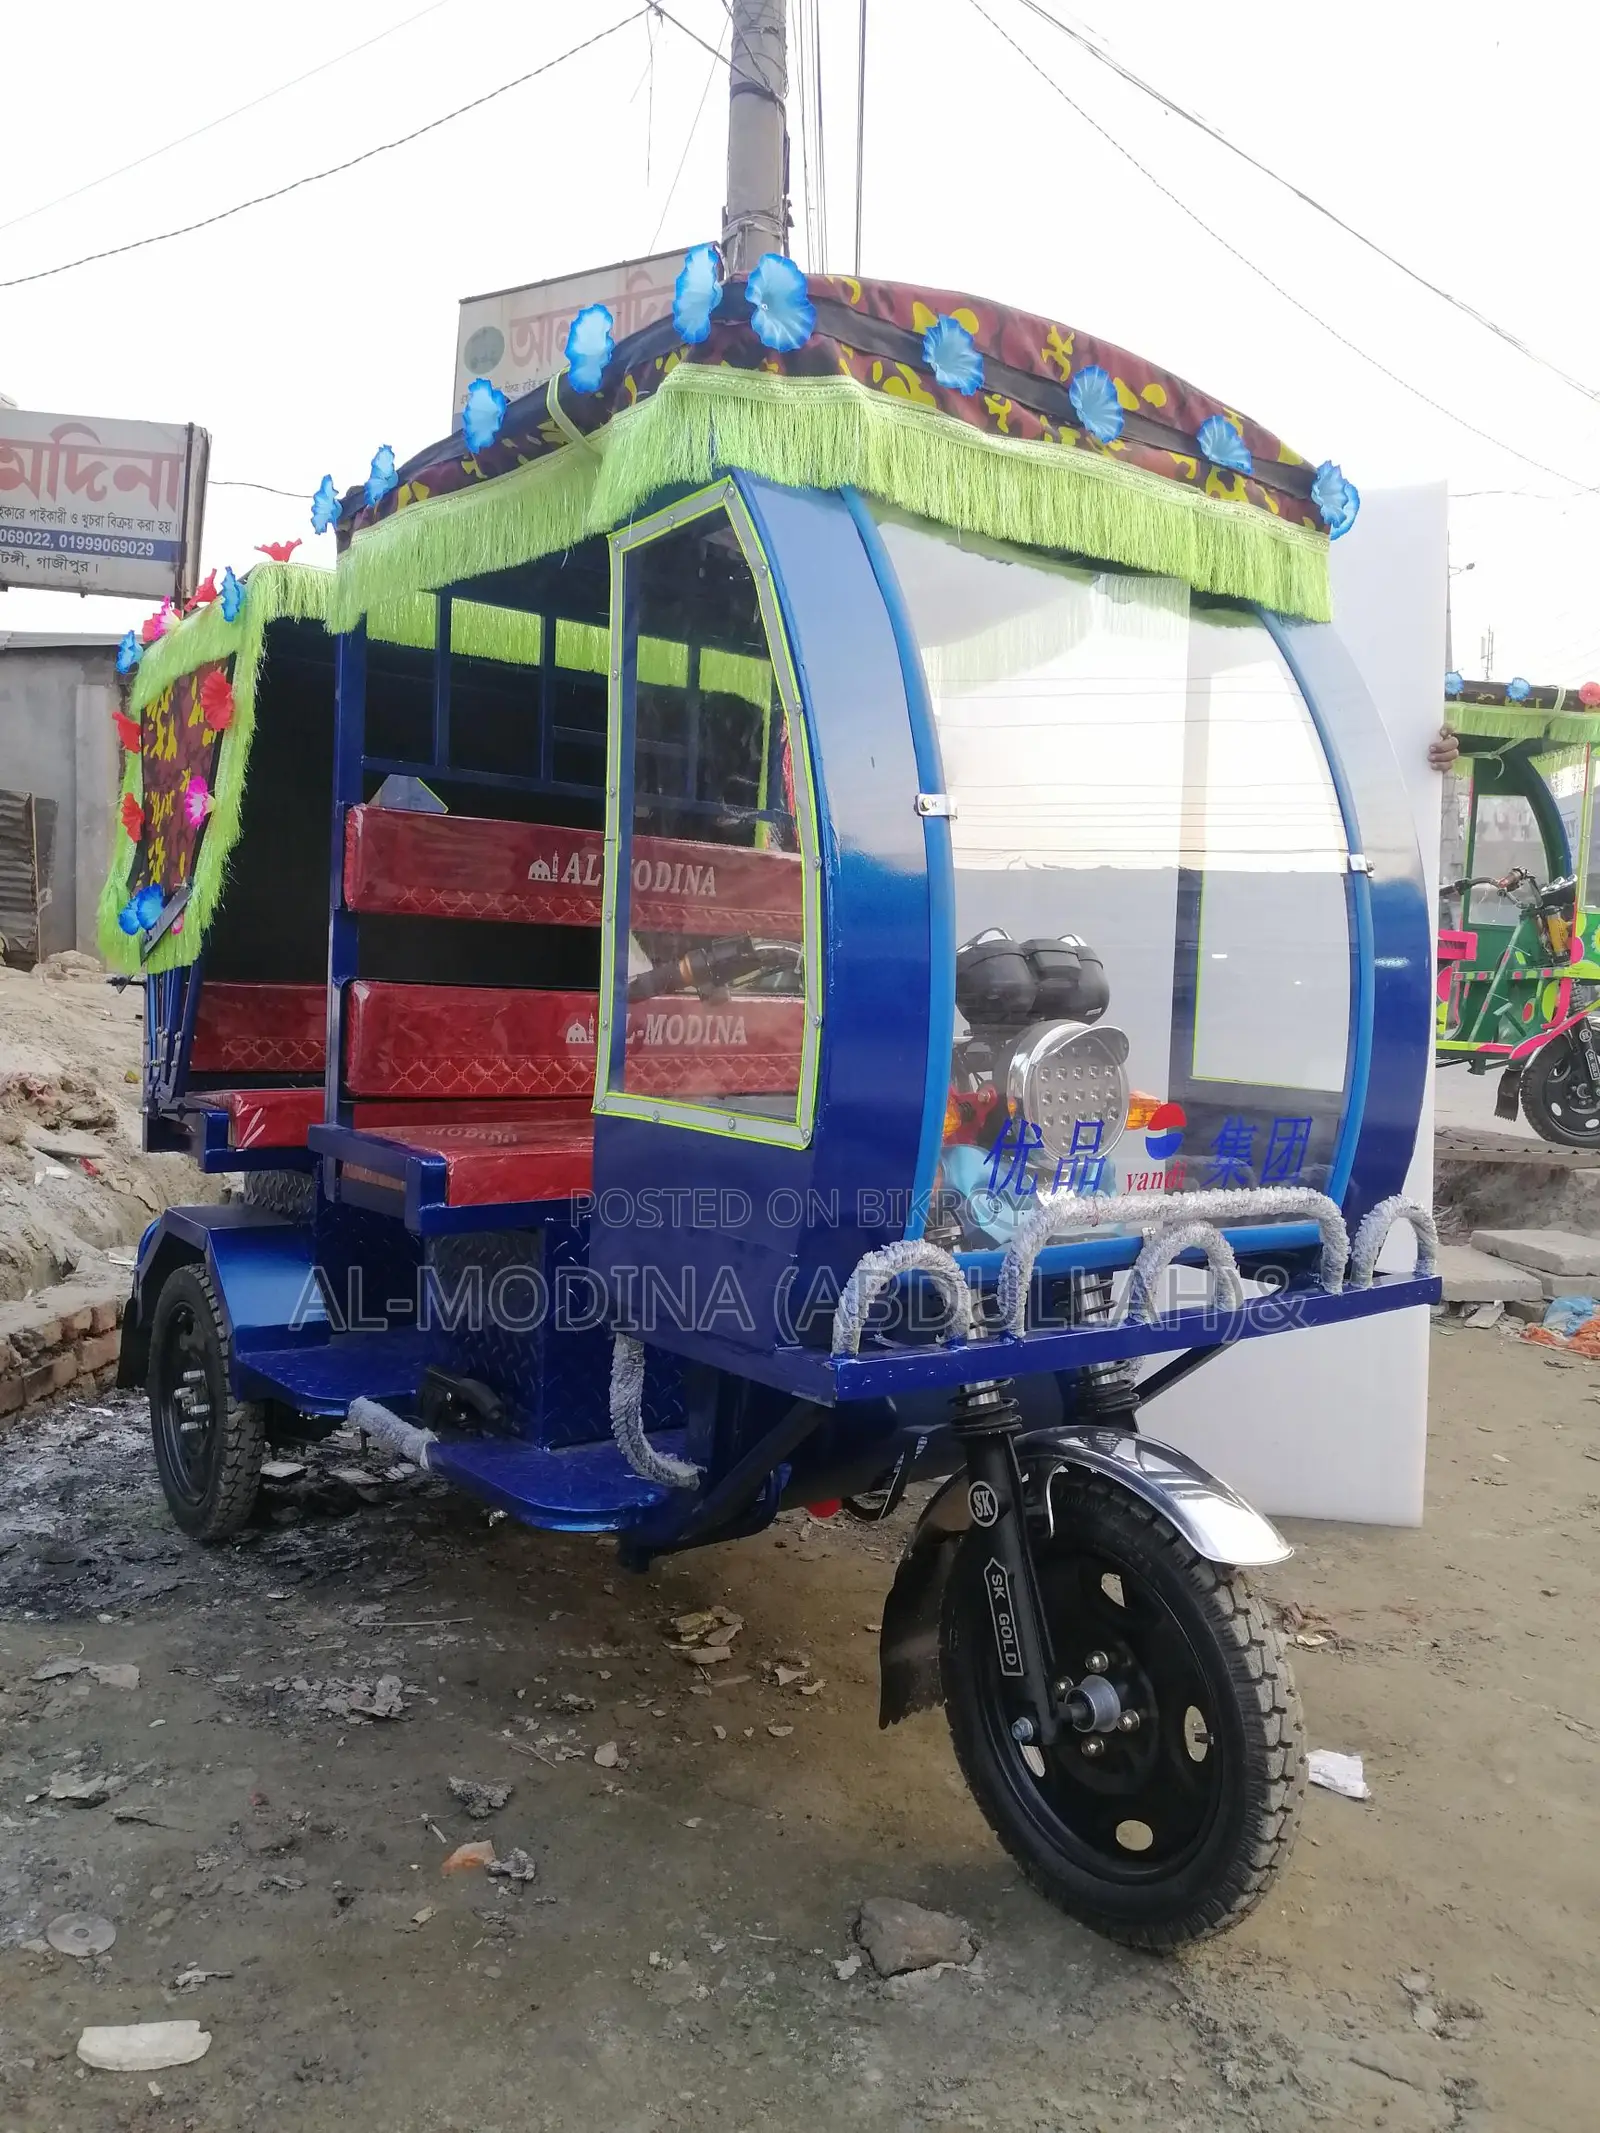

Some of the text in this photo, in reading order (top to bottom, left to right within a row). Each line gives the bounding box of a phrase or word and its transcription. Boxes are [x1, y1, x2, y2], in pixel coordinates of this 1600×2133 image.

[29, 507, 67, 524] পাইকারী
[82, 514, 105, 529] খুচরা
[136, 518, 155, 533] করা
[59, 534, 155, 556] 01999069029
[36, 554, 91, 577] গাজীপুর
[983, 1115, 1315, 1197] 优品 集团
[972, 1490, 994, 1518] SK
[991, 1574, 1018, 1667] SK GOLD
